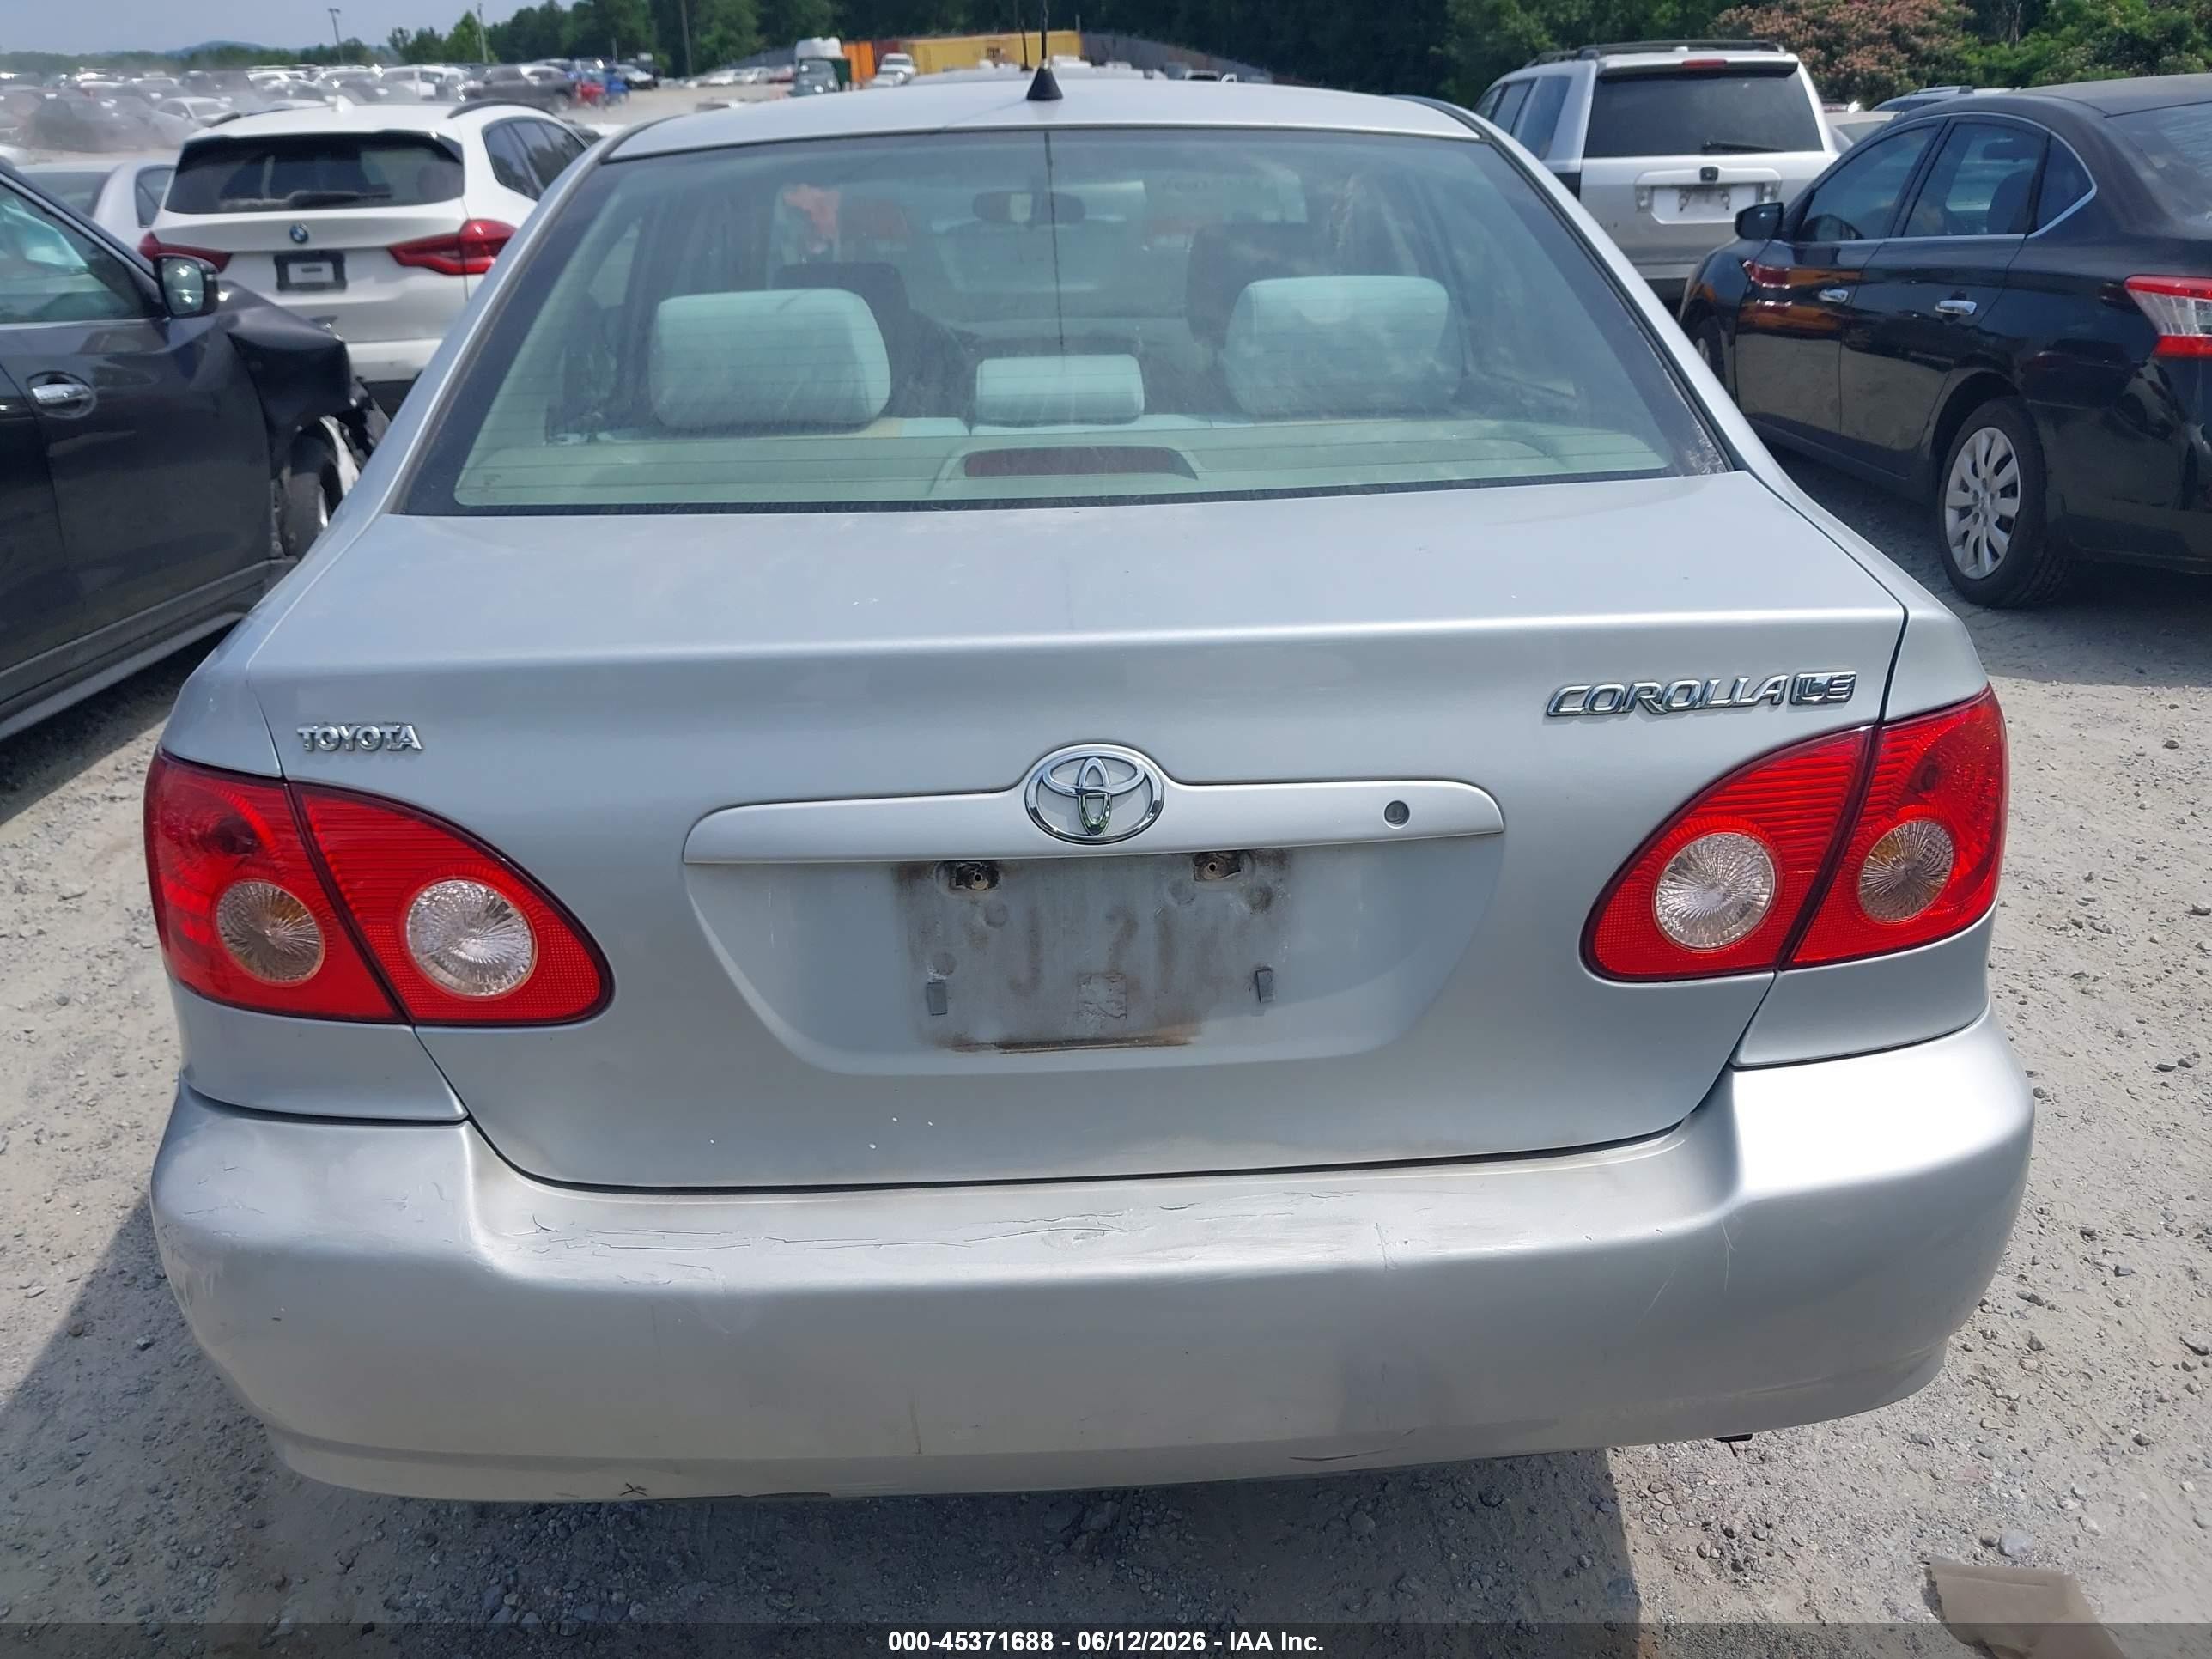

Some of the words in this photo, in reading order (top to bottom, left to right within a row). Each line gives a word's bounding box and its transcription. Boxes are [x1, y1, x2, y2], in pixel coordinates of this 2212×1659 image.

[1547, 673, 1789, 715] COROLLA
[1794, 671, 1856, 705] LE
[297, 724, 423, 752] TOYOTA
